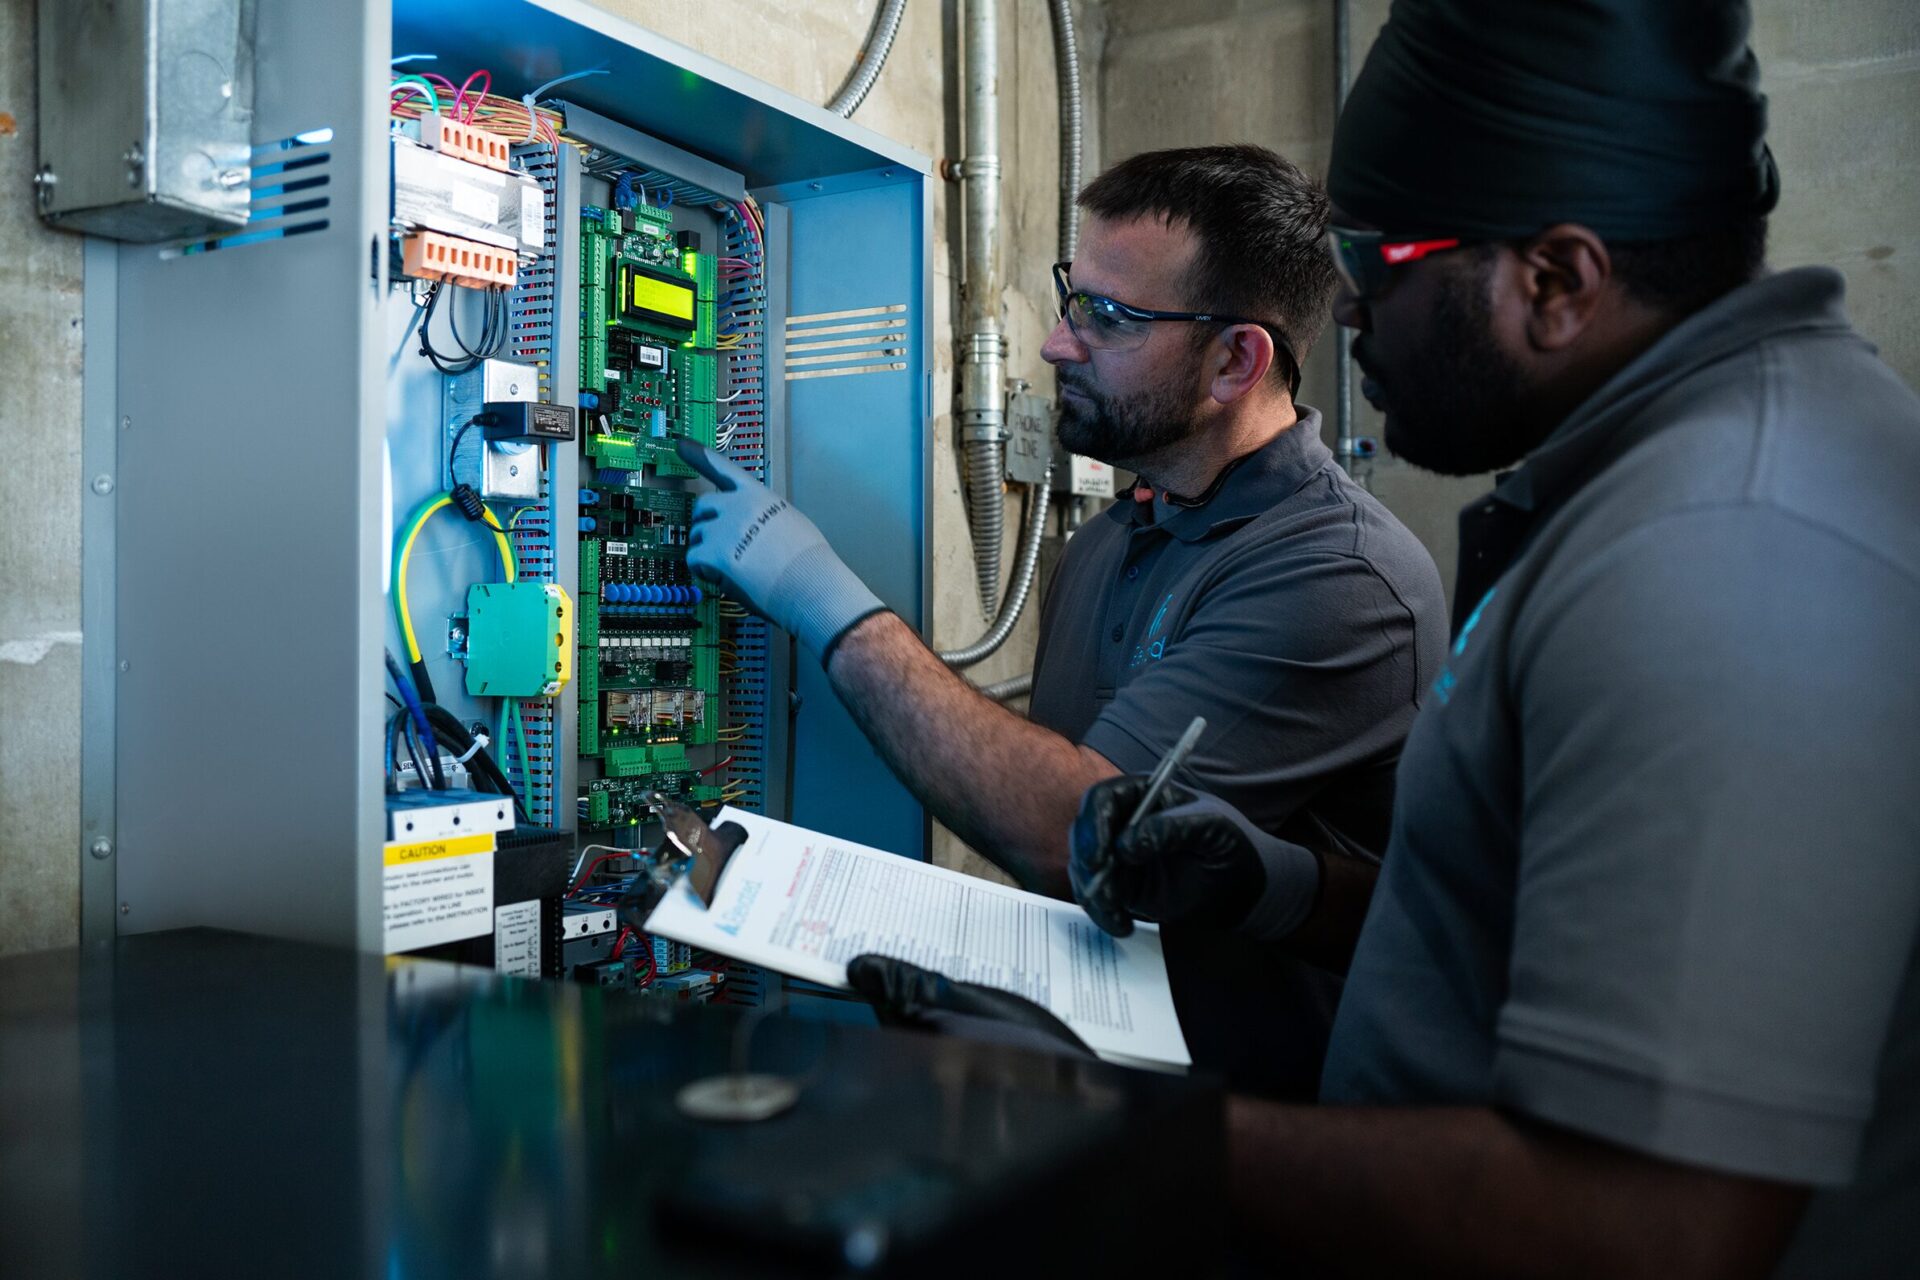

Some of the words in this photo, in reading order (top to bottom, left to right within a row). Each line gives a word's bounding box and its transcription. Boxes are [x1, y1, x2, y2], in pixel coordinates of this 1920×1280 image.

[1016, 413, 1043, 434] PHONE
[1014, 437, 1040, 460] LINE
[757, 500, 787, 526] FIRM
[734, 524, 760, 561] GRIP
[400, 844, 446, 860] CAUTION
[400, 897, 430, 907] FACTORY
[465, 887, 485, 896] INSIDE
[446, 906, 488, 919] INSTRUCTION
